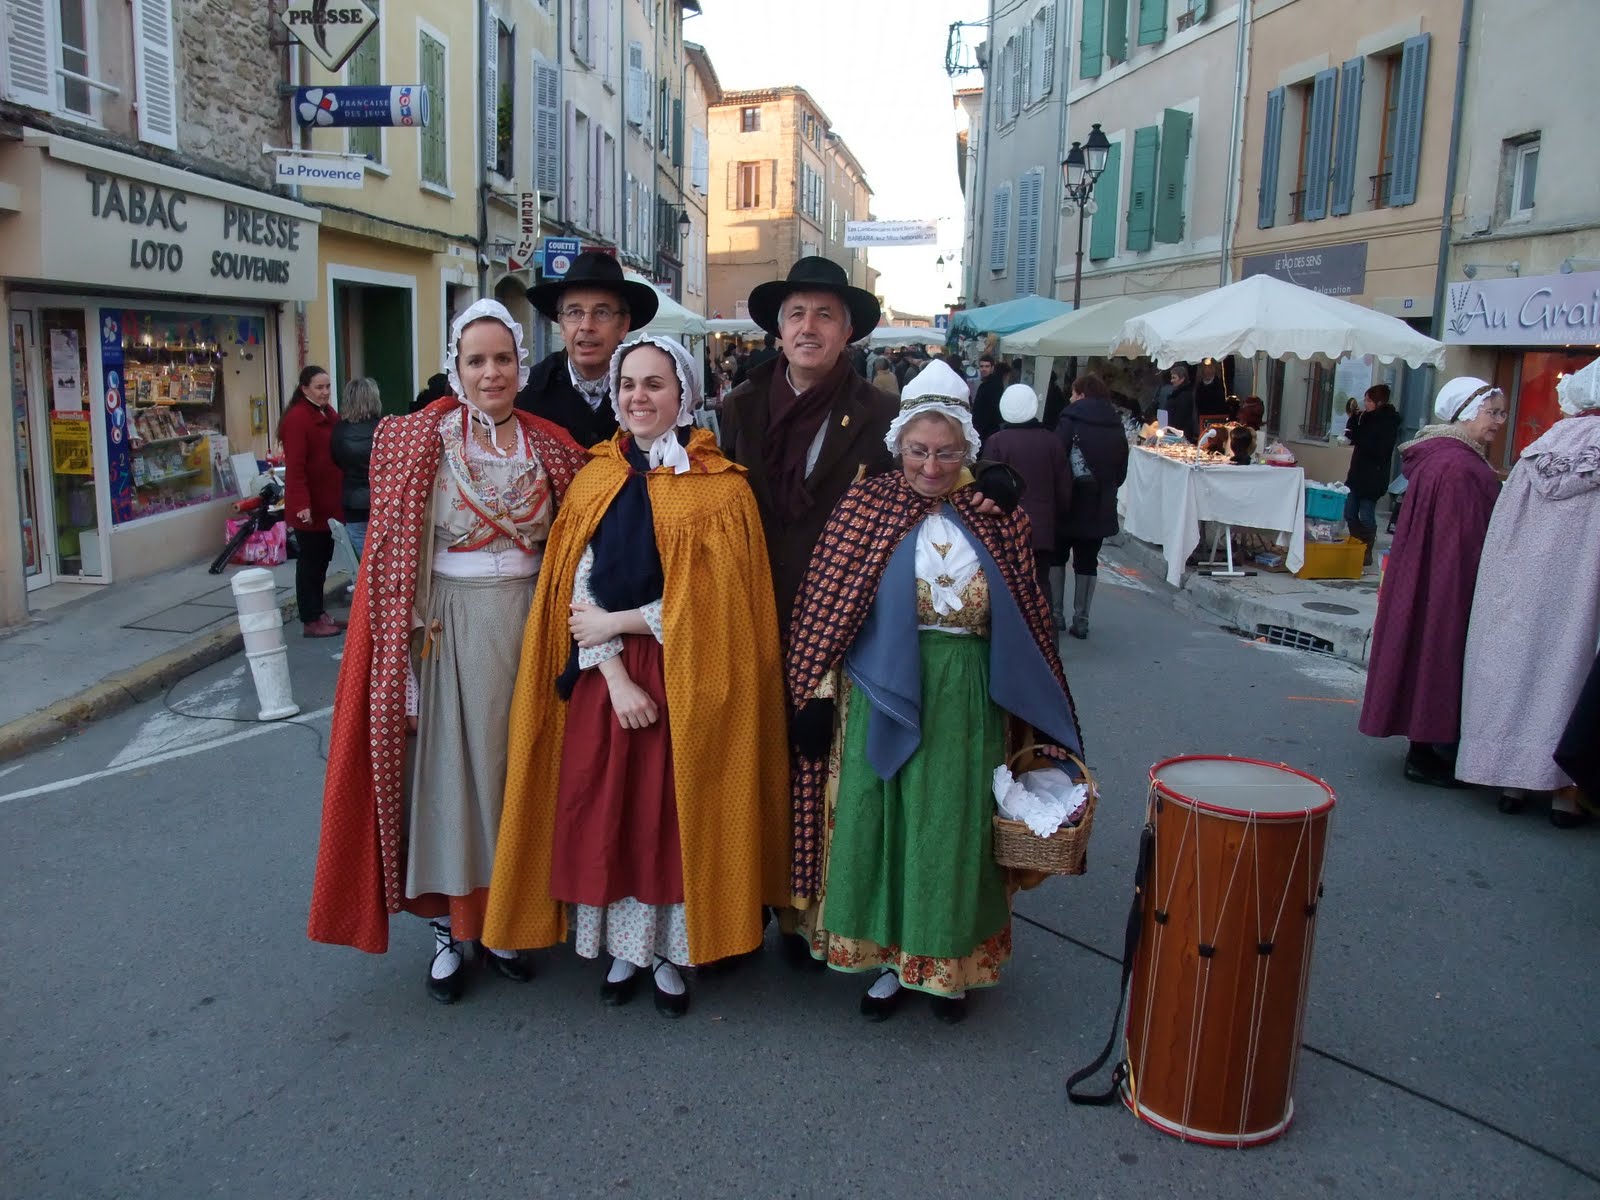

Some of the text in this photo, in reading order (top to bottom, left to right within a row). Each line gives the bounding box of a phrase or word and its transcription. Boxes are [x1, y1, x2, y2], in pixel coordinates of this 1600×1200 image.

[289, 8, 363, 25] PRESSE
[364, 110, 387, 118] JEUX
[400, 87, 413, 126] LOTO
[279, 163, 361, 181] La Provence
[86, 172, 300, 251] TABAC PRESSE
[517, 192, 534, 258] PRESSING
[548, 241, 576, 251] COUETTE
[130, 238, 290, 284] LOTO SOUVENIRS
[1462, 287, 1600, 333] Au Grai
[1541, 329, 1600, 341] www.au
